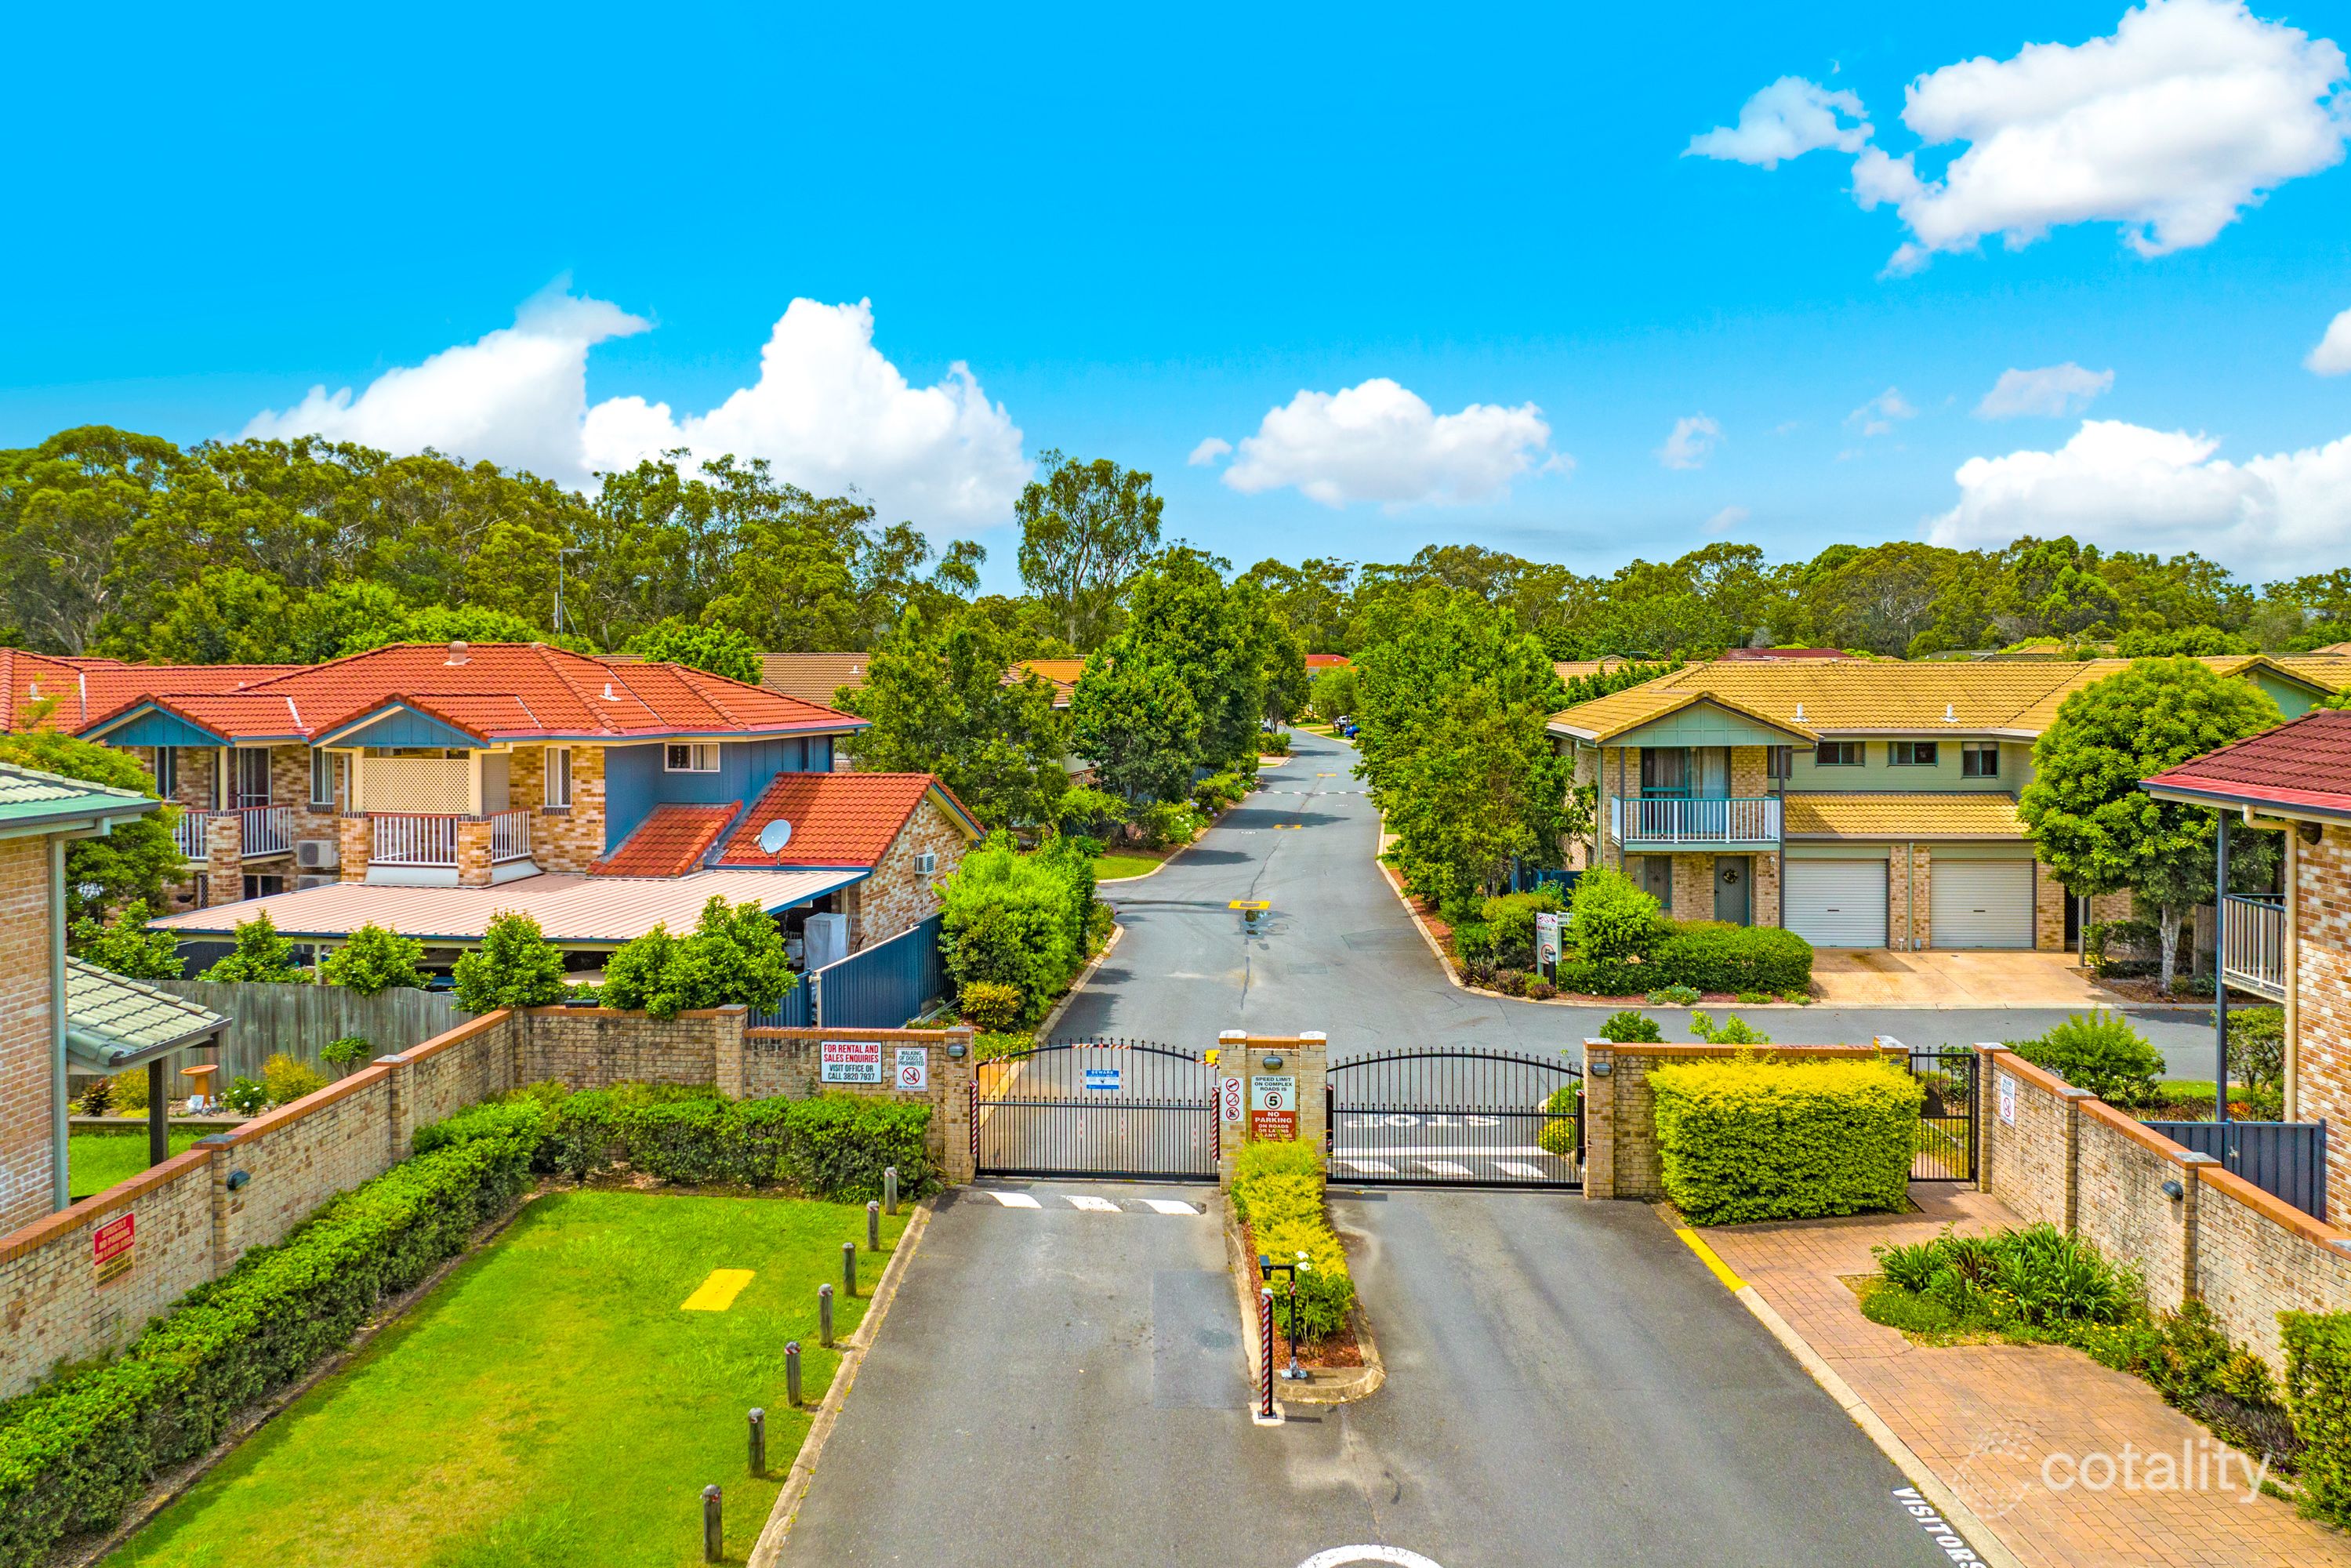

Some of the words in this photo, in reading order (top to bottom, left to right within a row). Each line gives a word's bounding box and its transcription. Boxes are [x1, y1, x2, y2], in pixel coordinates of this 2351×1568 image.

[824, 1044, 836, 1053] FOR
[838, 1044, 864, 1054] RENTAL
[865, 1044, 879, 1054] AND
[824, 1053, 844, 1062] SALES
[845, 1054, 879, 1063] ENQUIRIES
[844, 1064, 865, 1073] OFFICE
[828, 1072, 842, 1080] CALL
[1268, 1095, 1278, 1106] 5
